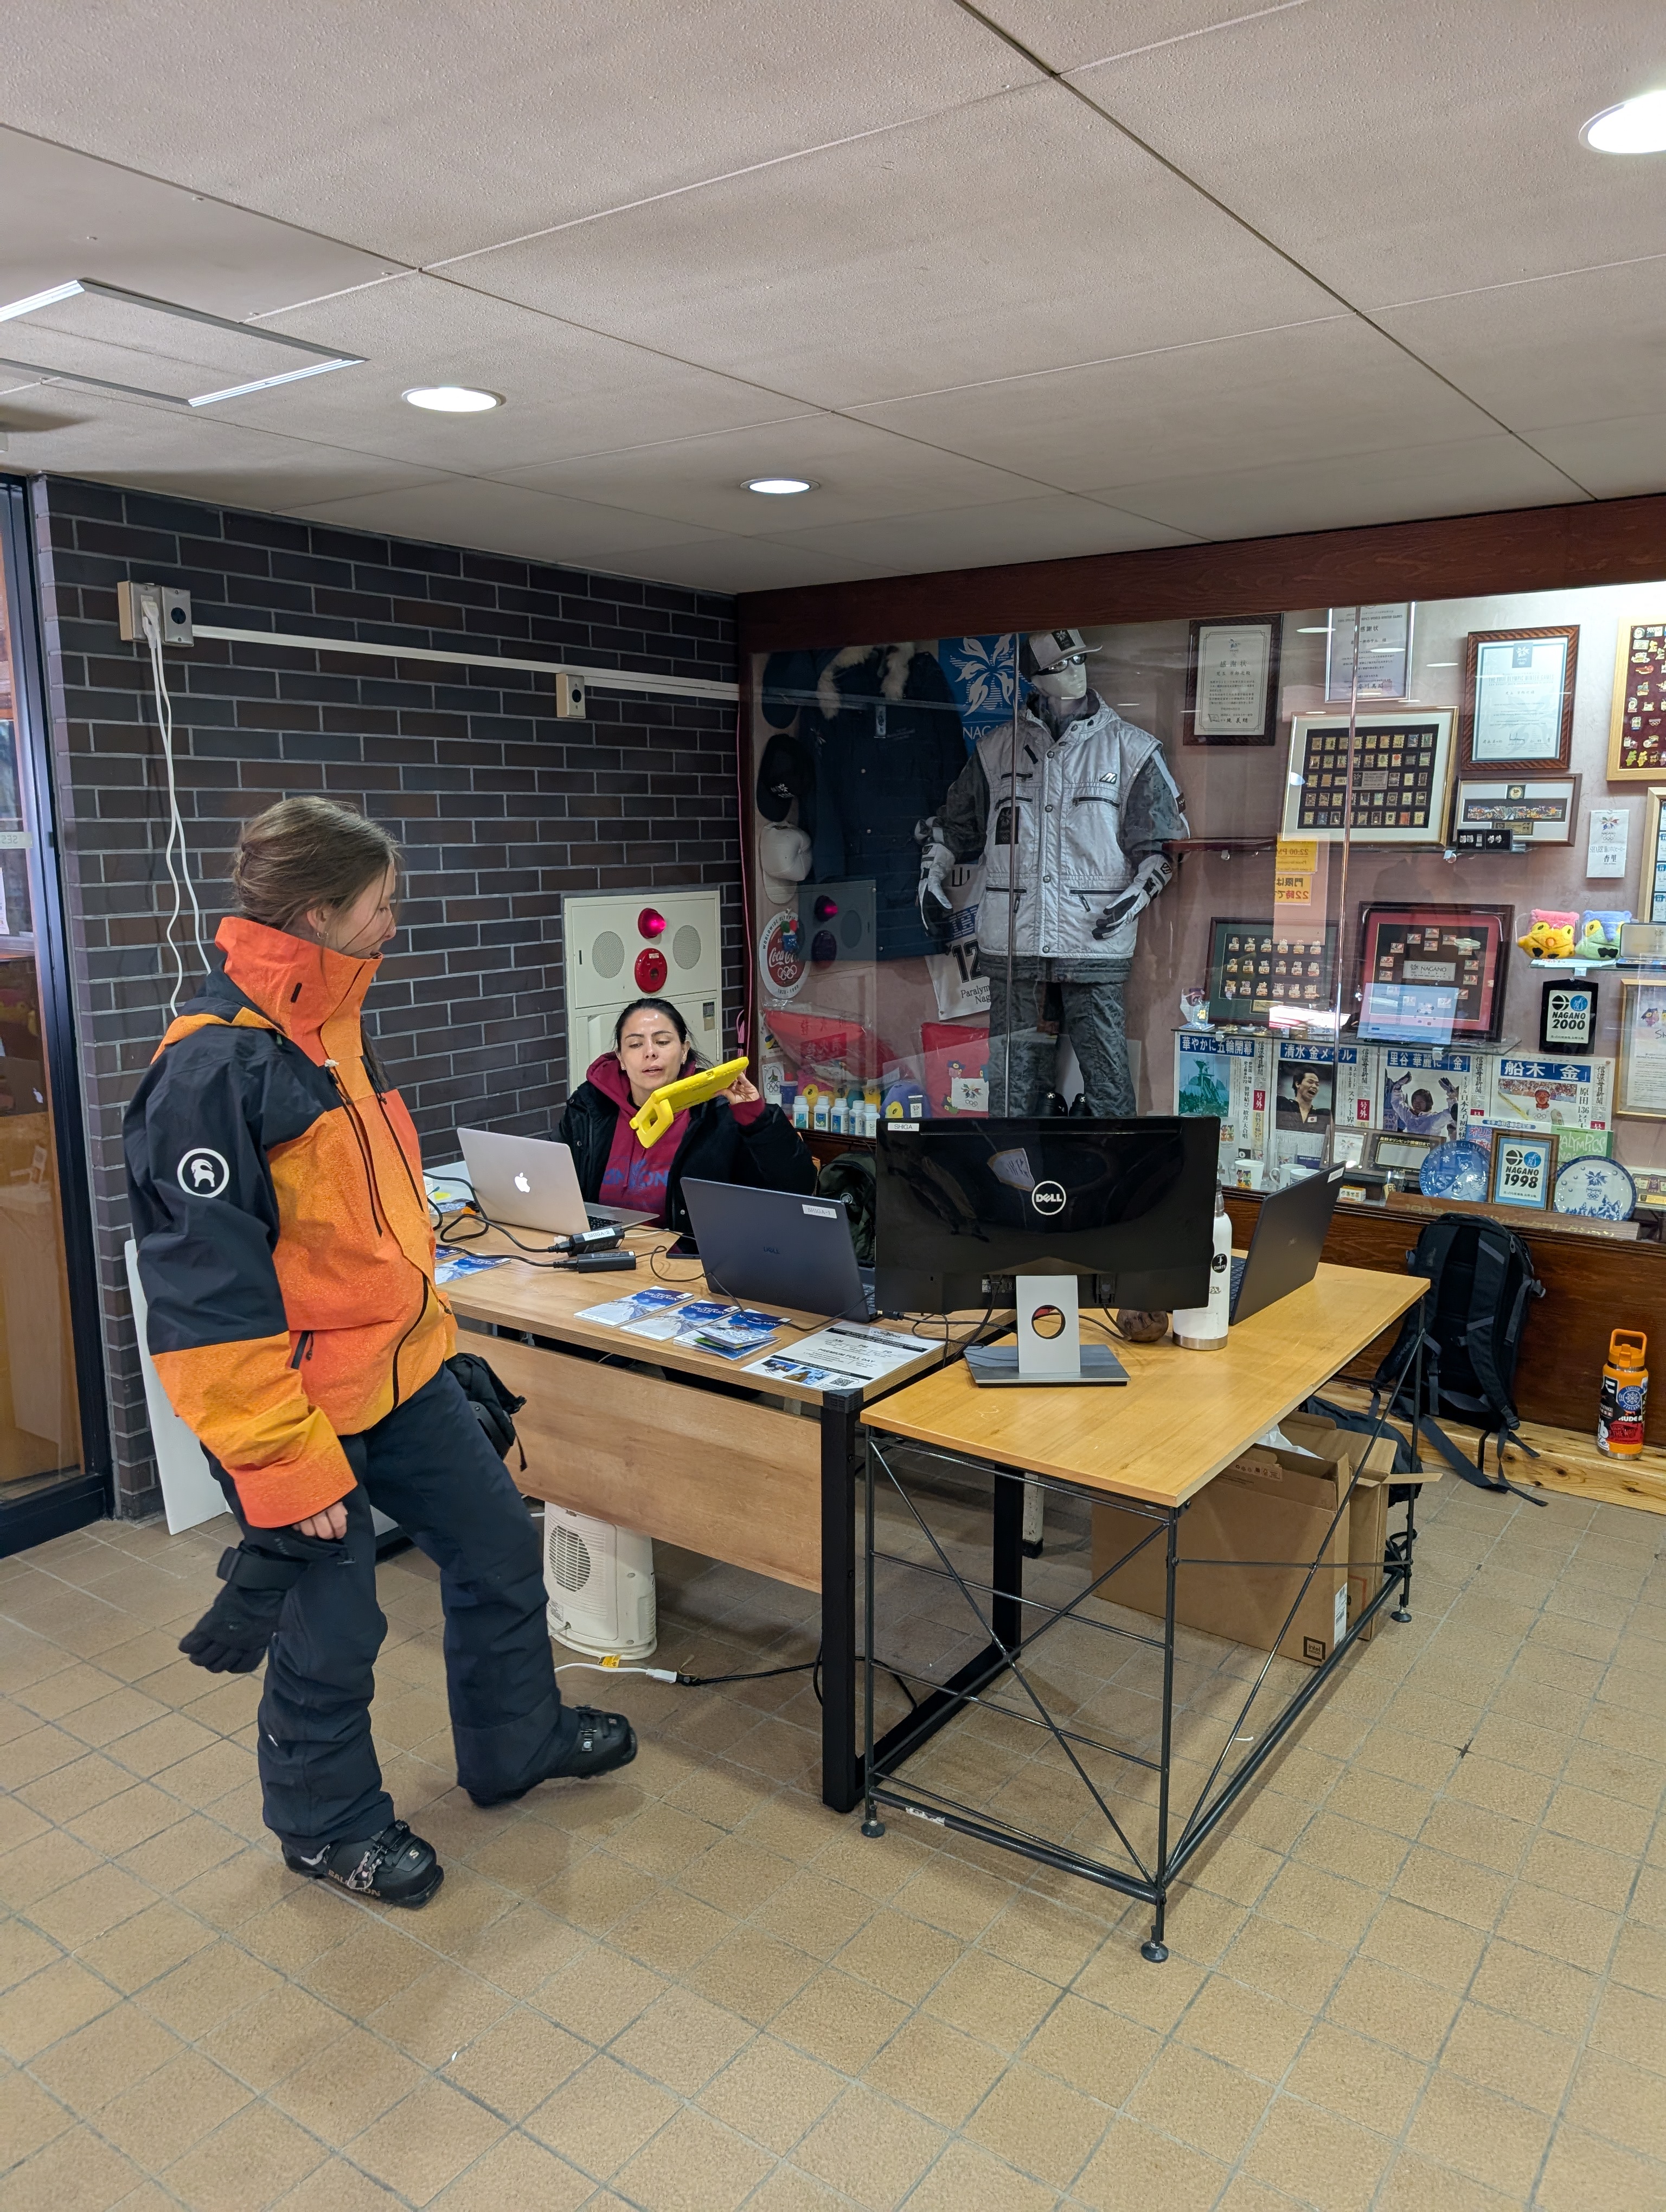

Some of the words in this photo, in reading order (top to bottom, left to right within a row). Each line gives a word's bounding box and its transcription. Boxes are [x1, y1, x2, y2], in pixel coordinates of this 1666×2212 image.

[1552, 1011, 1586, 1020] NAGANO
[1552, 1019, 1585, 1030] 2000
[1182, 1036, 1253, 1056] 華やかに五輪開幕
[1284, 1043, 1305, 1059] 清水
[1389, 1051, 1409, 1066] 里谷
[1504, 1060, 1546, 1078] 船木
[1255, 1091, 1263, 1109] 号外
[1579, 1087, 1590, 1105] 原田
[1360, 1101, 1367, 1118] 号外
[1577, 1106, 1590, 1114] 136
[1505, 1166, 1539, 1176] NAGANO
[1504, 1173, 1539, 1188] 1998
[1036, 1193, 1063, 1203] DELL
[587, 1230, 610, 1238] SHIGA-2
[818, 1348, 844, 1356] PREMIUM
[1308, 1643, 1321, 1652] intel
[328, 1869, 381, 1896] SALON
